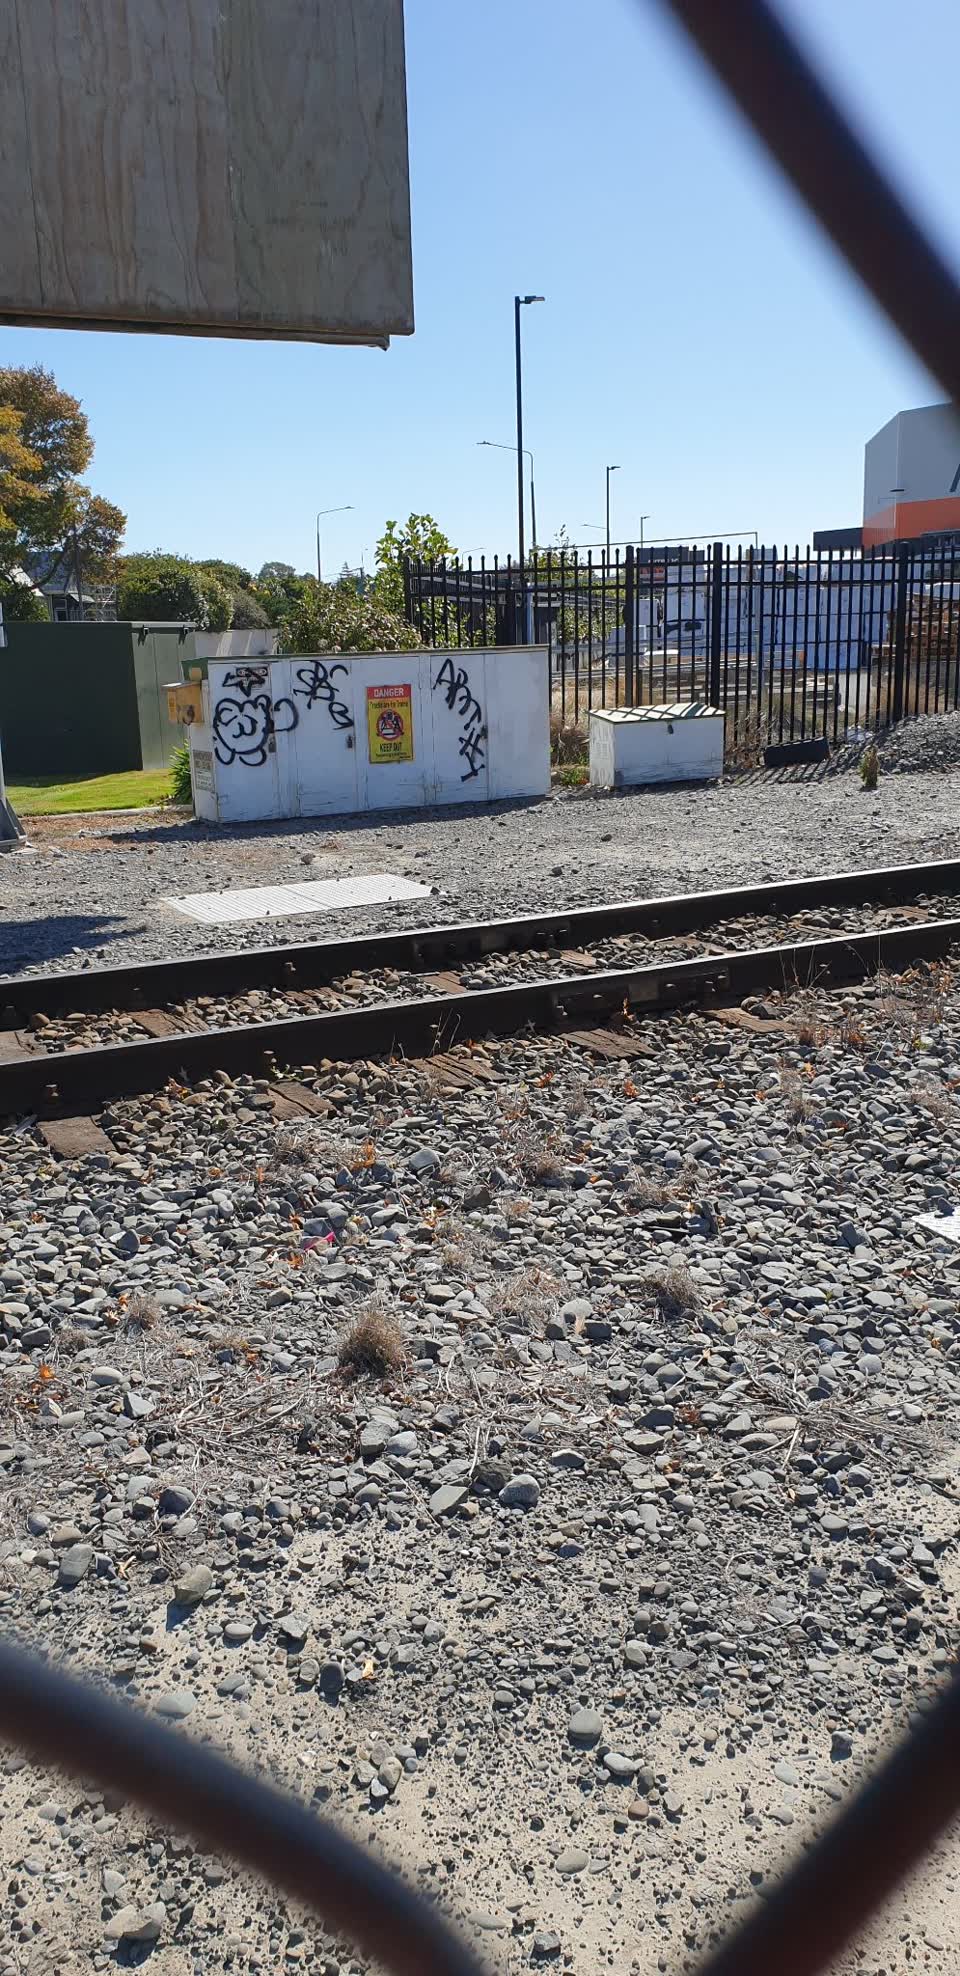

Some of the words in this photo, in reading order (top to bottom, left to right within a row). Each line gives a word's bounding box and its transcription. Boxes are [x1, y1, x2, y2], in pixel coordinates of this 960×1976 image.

[374, 687, 404, 697] DANGER
[379, 743, 393, 752] KEEP
[393, 742, 402, 752] OUT
